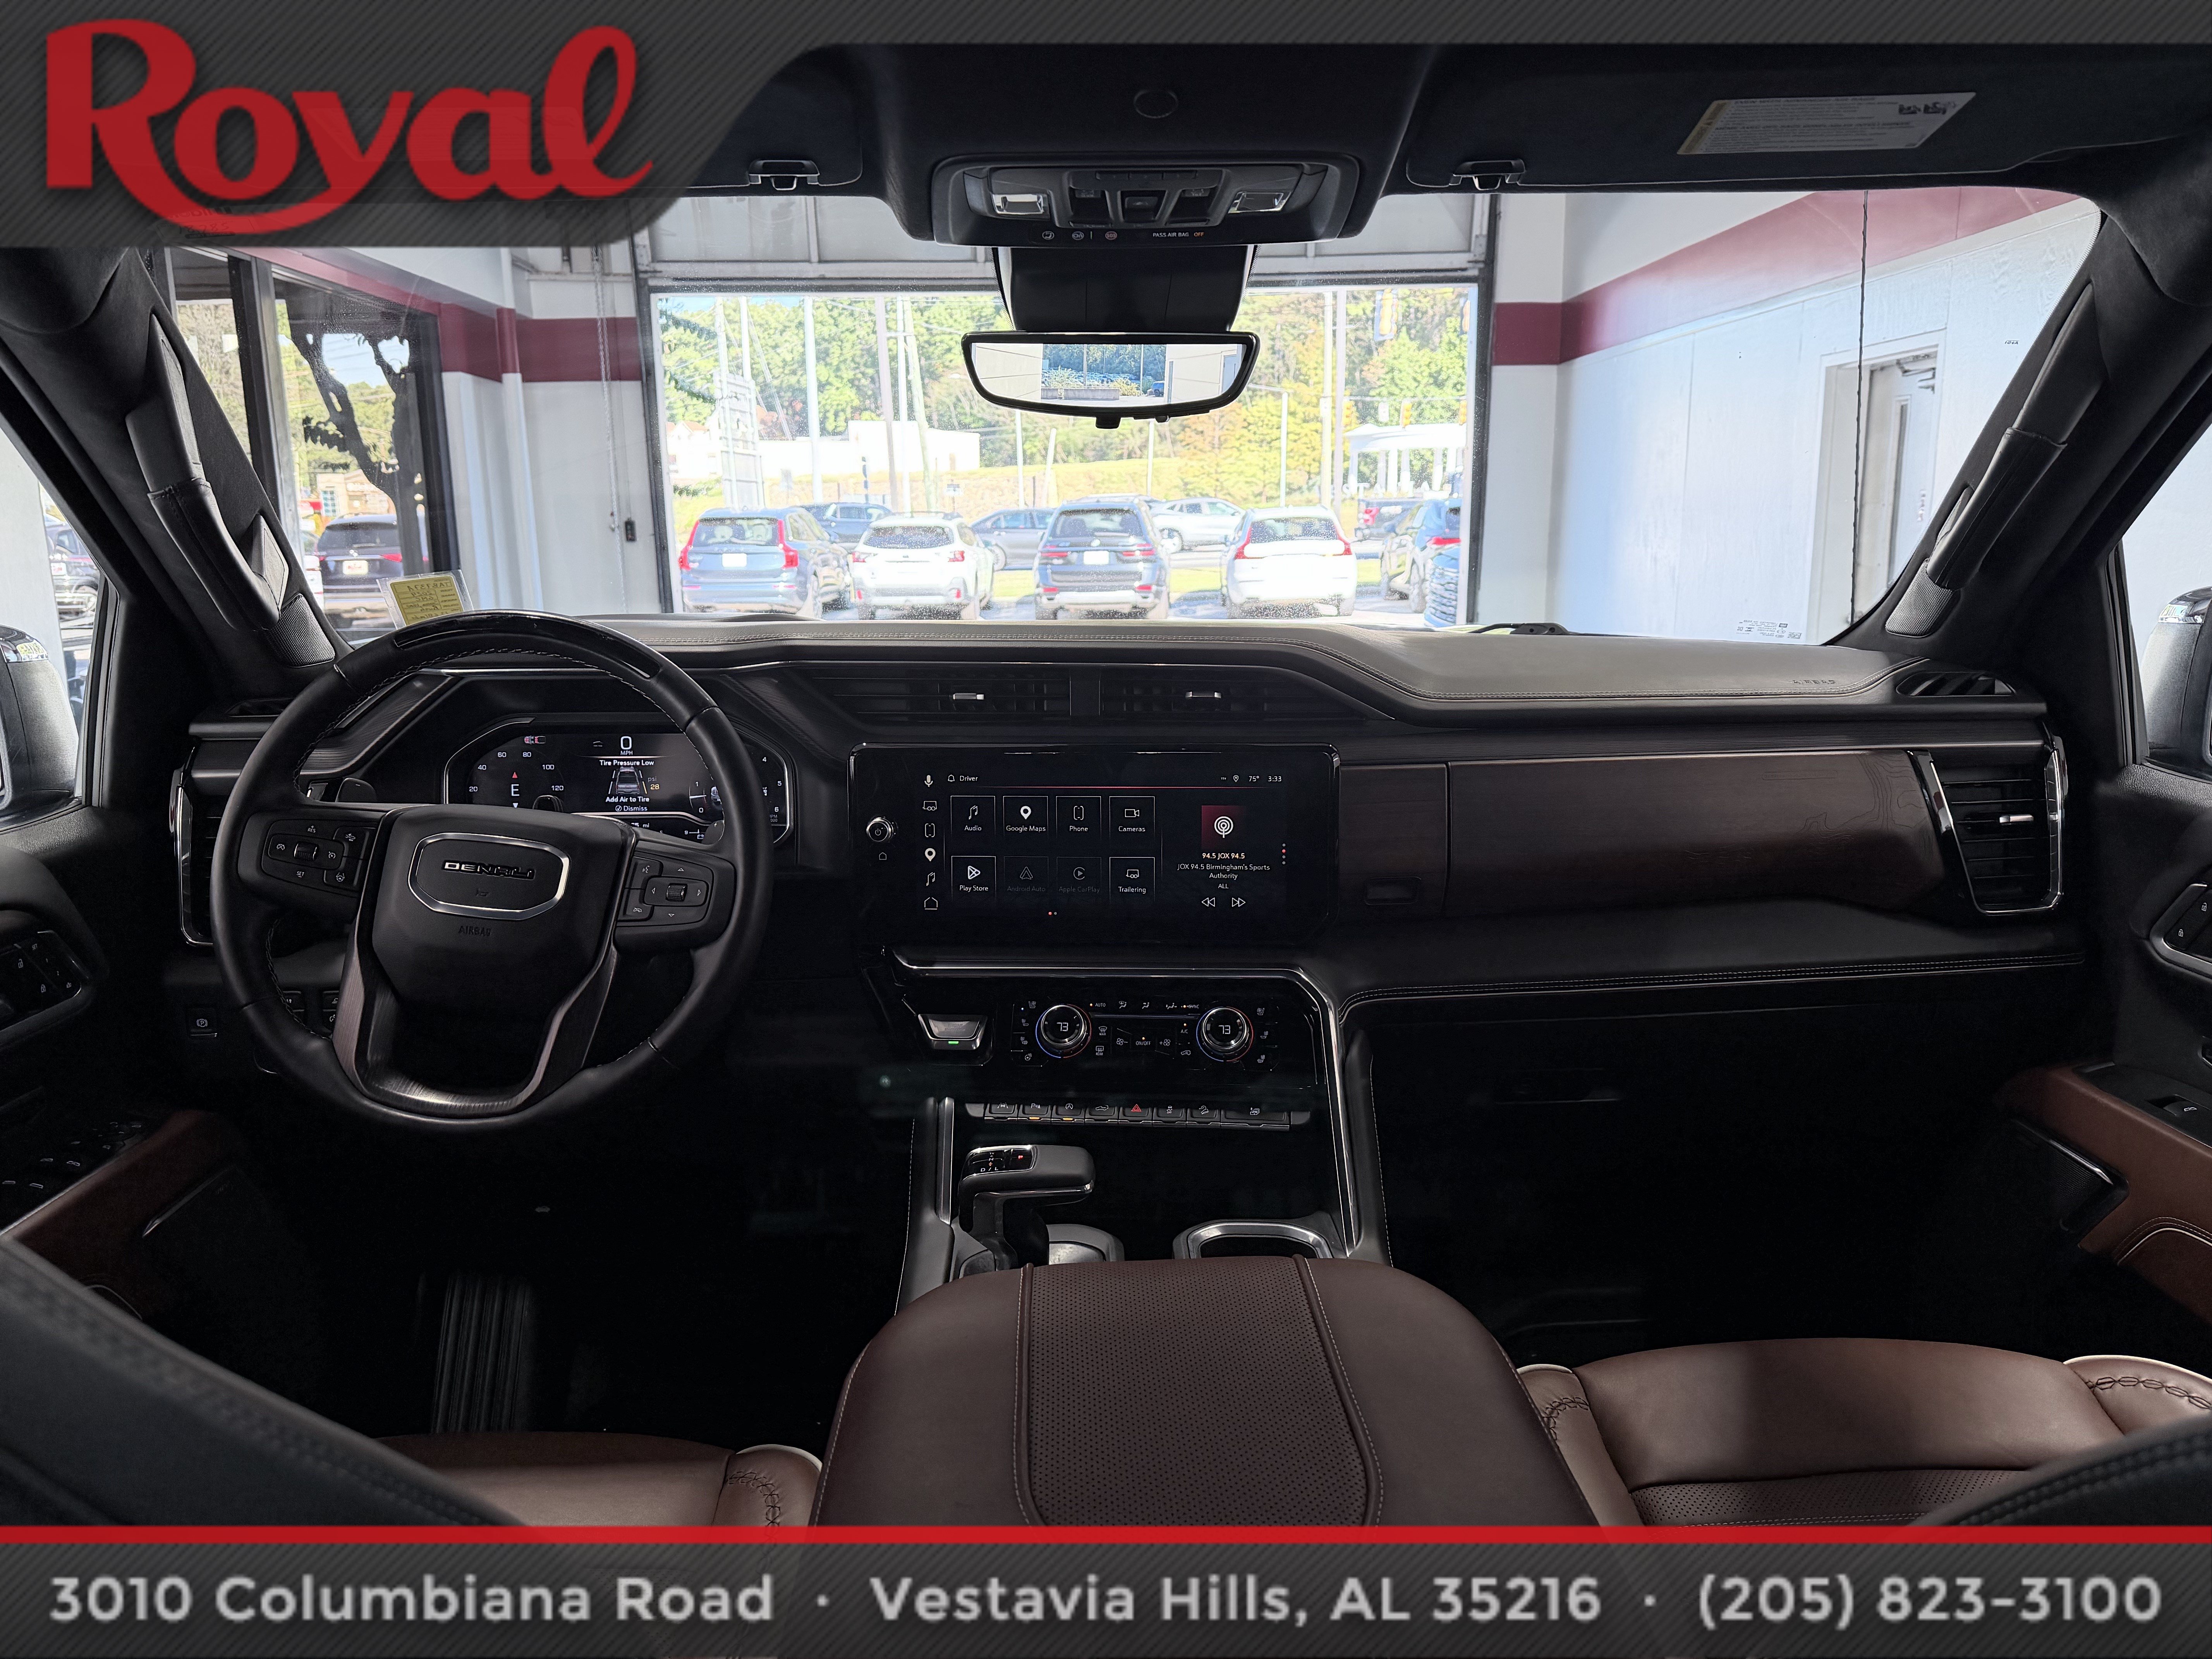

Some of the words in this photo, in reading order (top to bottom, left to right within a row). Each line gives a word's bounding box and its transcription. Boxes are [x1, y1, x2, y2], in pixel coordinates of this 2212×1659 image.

[621, 736, 632, 750] 0
[511, 784, 519, 796] E
[444, 861, 534, 879] DENALI
[458, 926, 491, 936] AIRBAG
[1057, 1022, 1068, 1031] 73
[1219, 1025, 1230, 1034] 73
